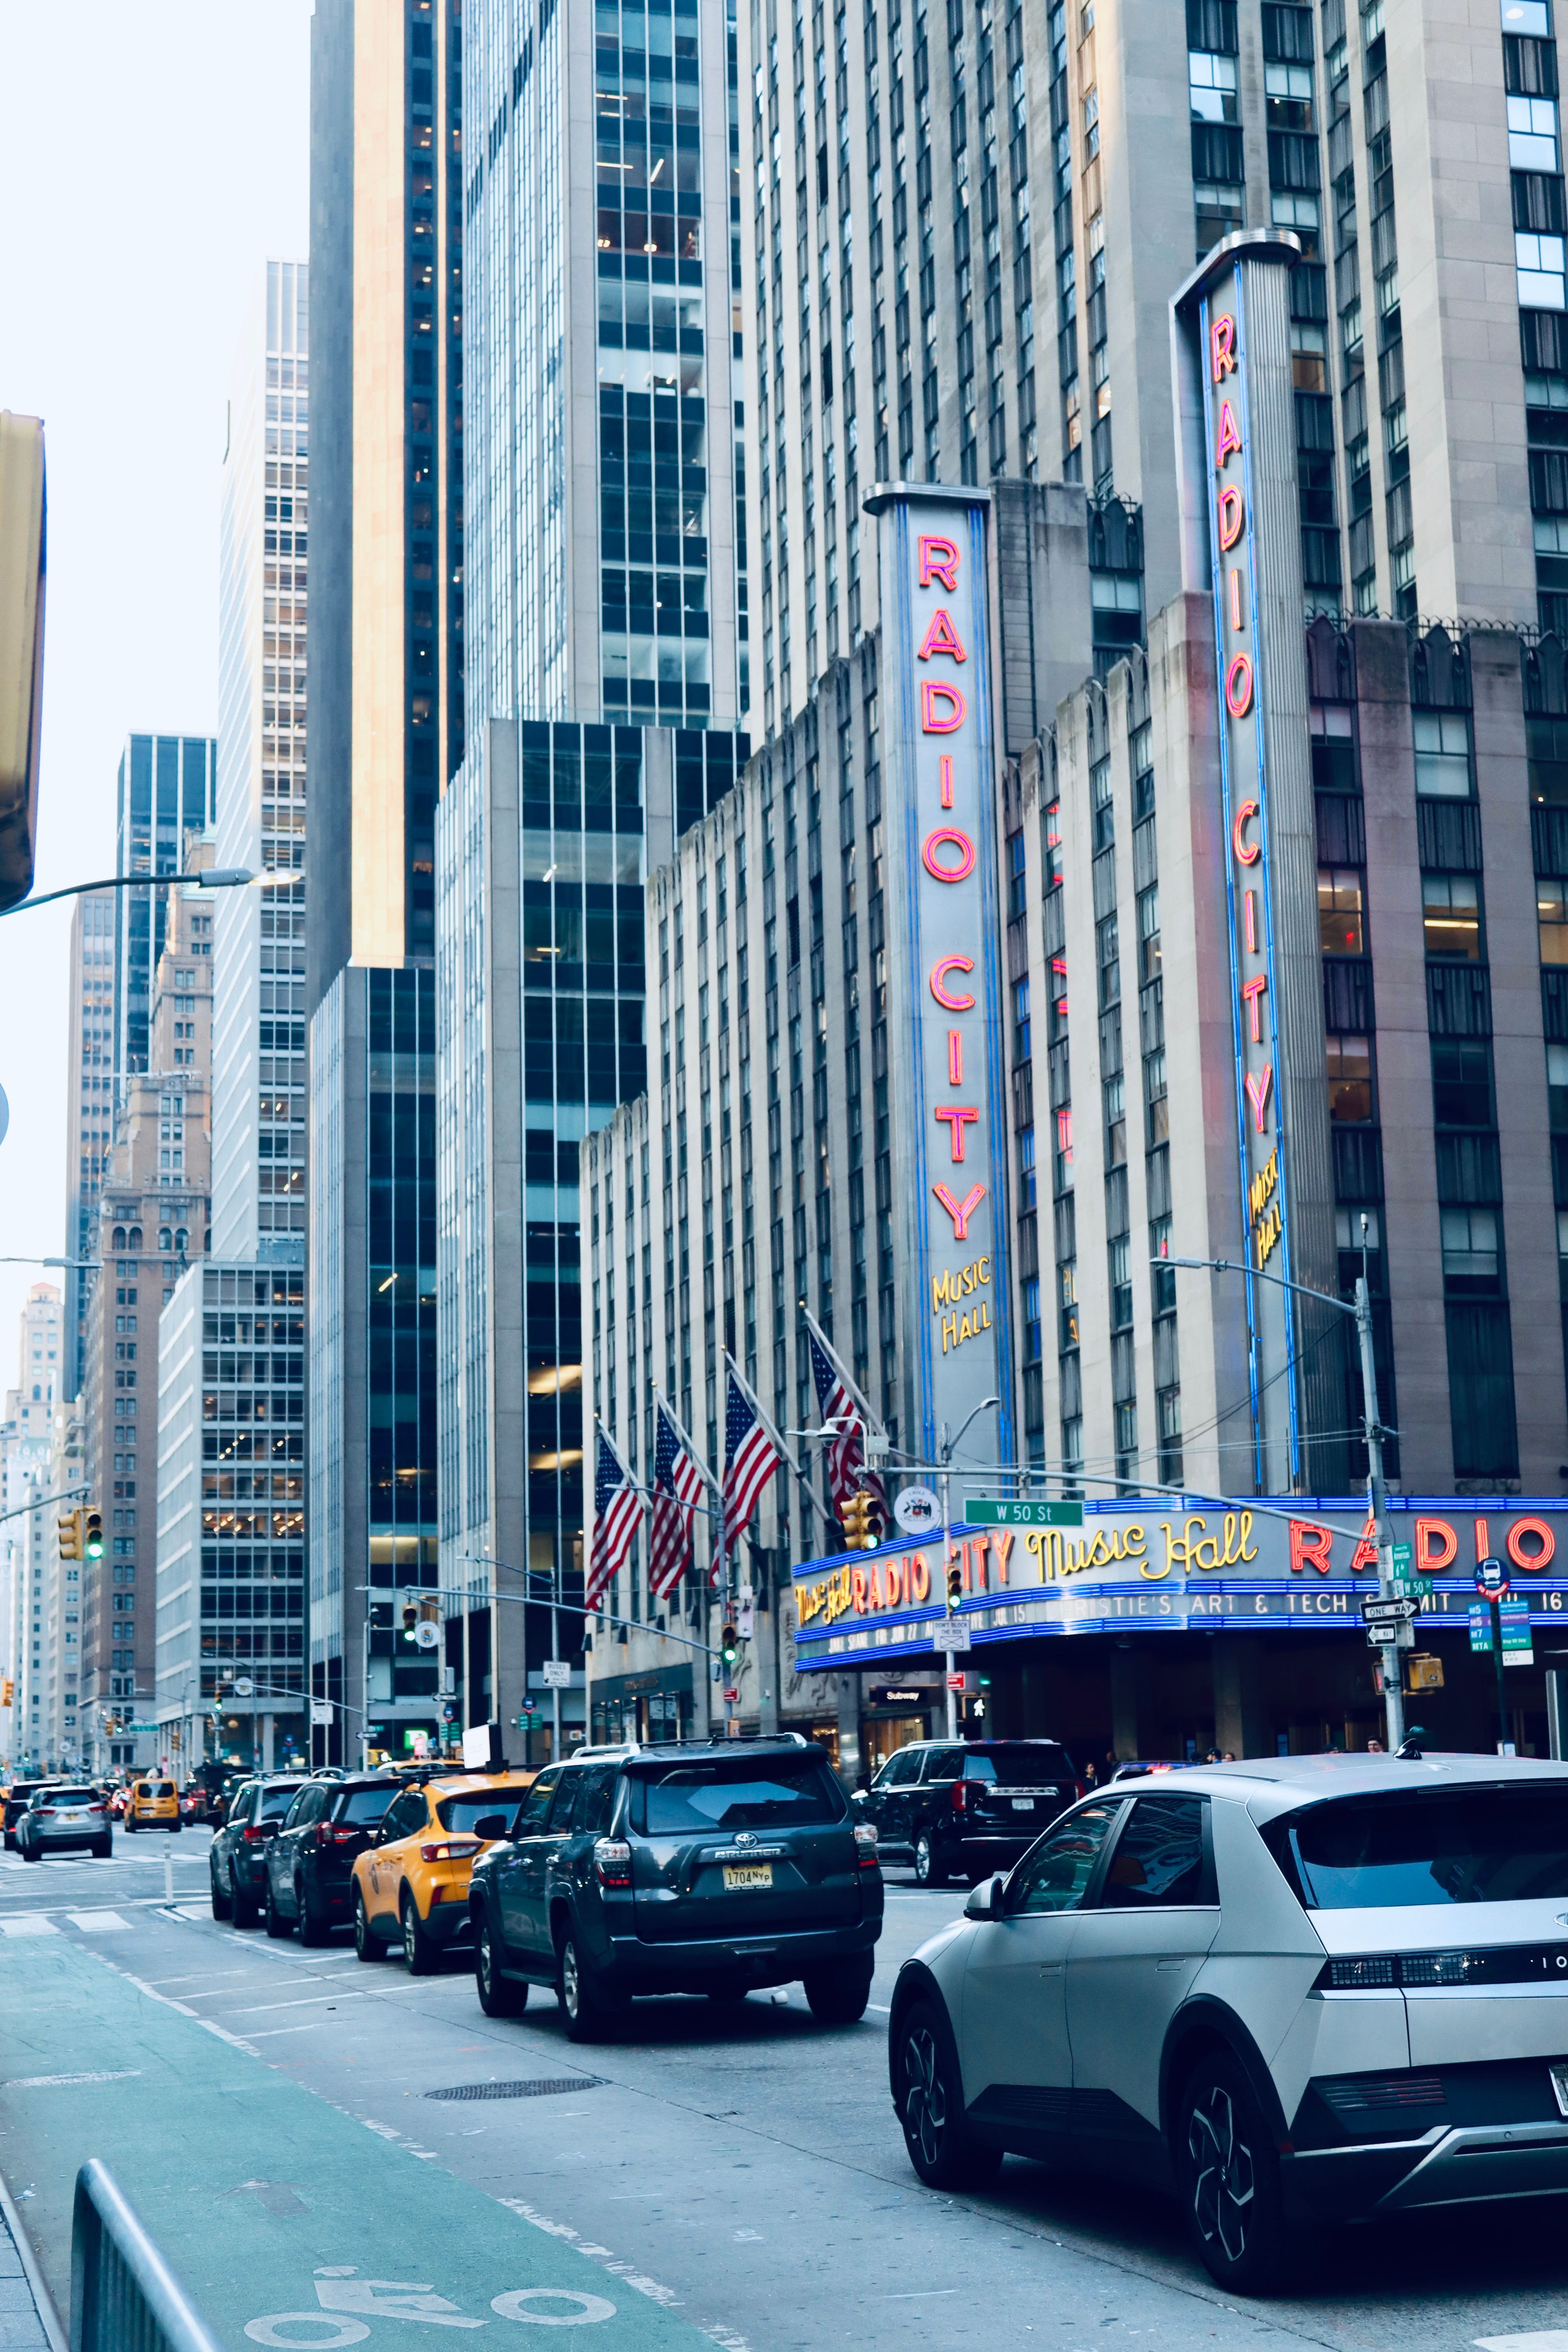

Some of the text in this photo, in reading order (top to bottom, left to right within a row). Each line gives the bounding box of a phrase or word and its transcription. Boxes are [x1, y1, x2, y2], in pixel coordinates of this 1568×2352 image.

[1211, 312, 1273, 1133] RADIO CITY
[917, 534, 986, 1240] RADIO CITY
[933, 1256, 990, 1313] MUSIC
[942, 1301, 991, 1353] HALL
[996, 1505, 1052, 1521] W 50 St
[1025, 1510, 1258, 1583] Music Hall
[852, 1530, 1012, 1614] RADIO ITY
[1404, 1582, 1411, 1594] W
[1413, 1581, 1424, 1594] 50
[1191, 1595, 1236, 1613] ART
[1255, 1594, 1268, 1613] &
[1286, 1593, 1347, 1613] TECH
[1370, 1604, 1411, 1617] ONE WAY
[1469, 1605, 1481, 1614] M5
[993, 1604, 1026, 1626] JUL 15
[1470, 1616, 1482, 1626] M5
[907, 1623, 917, 1641] 27
[1471, 1629, 1483, 1638] M7
[1472, 1642, 1489, 1650] MTA
[887, 1691, 920, 1701] Subway
